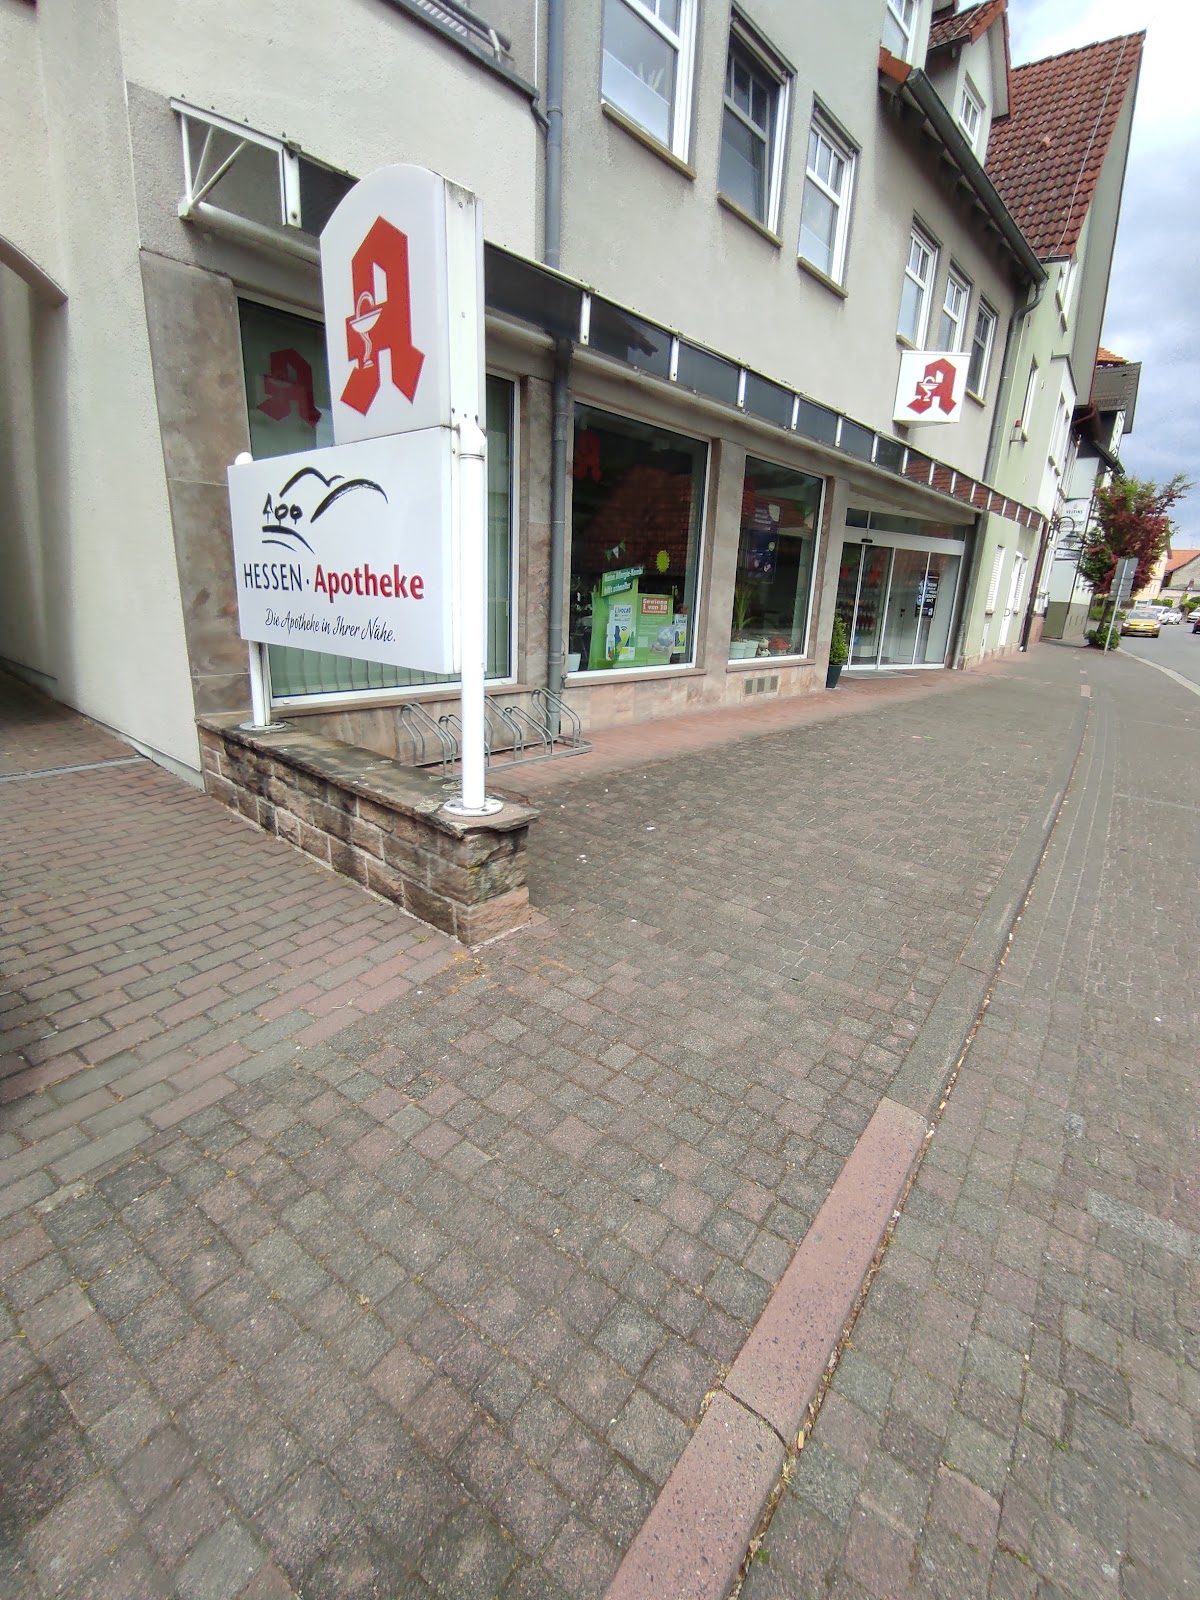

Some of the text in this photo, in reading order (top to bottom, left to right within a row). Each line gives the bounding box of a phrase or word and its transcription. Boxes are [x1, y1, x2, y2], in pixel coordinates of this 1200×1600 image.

[243, 563, 425, 603] HESSEN Apotheke
[265, 608, 396, 642] Die Apotheke in Ihrer Nähe.
